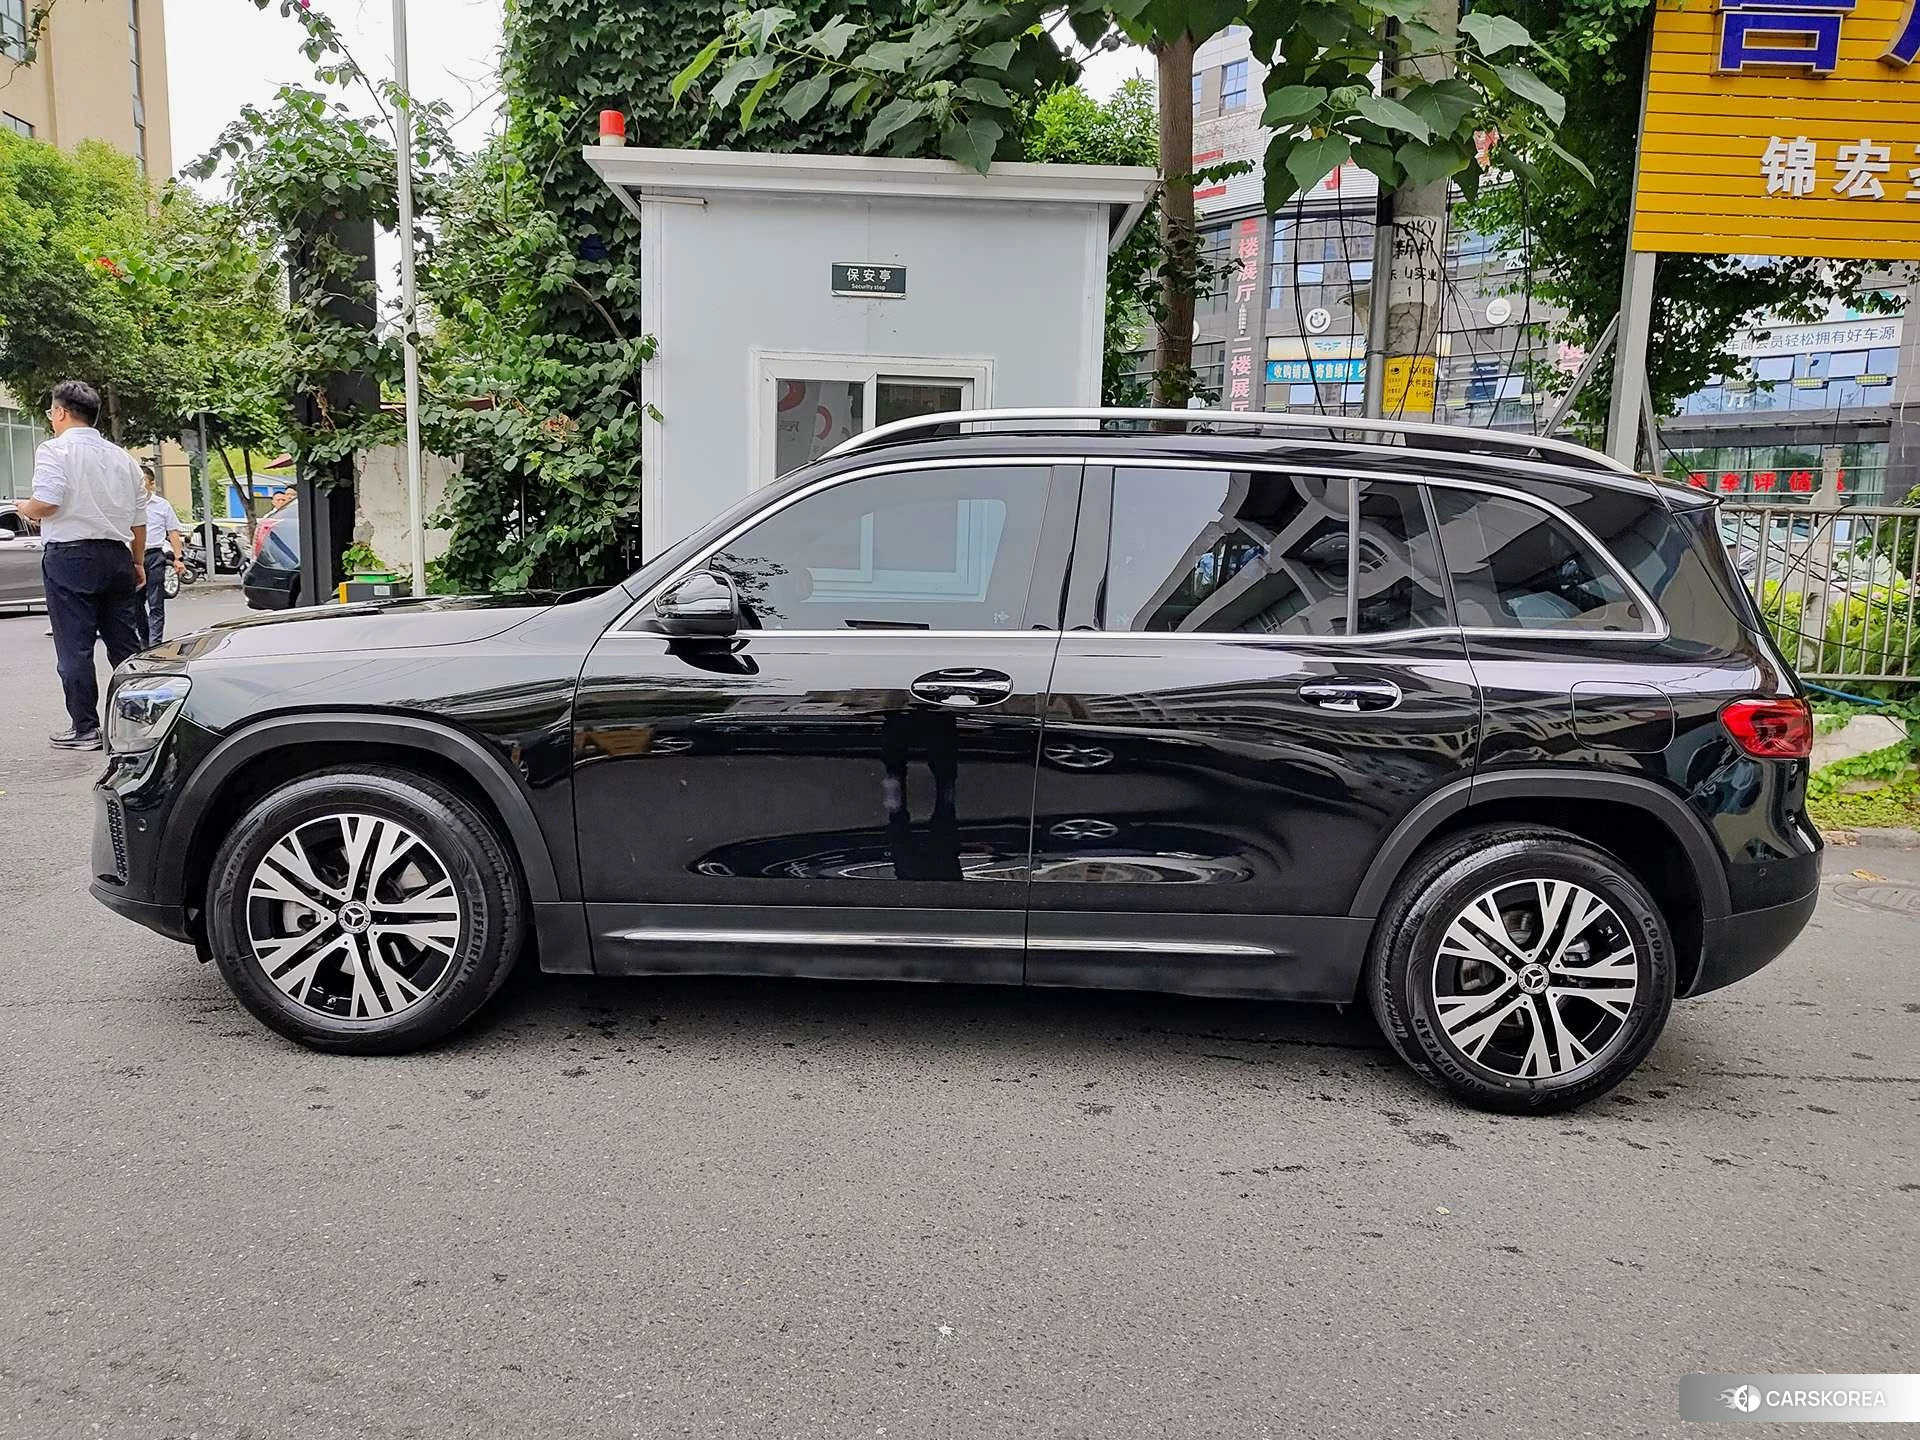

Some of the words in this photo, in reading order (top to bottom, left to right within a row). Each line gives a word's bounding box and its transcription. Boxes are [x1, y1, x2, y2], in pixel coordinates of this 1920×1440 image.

[1760, 136, 1920, 200] 锦宏
[846, 267, 892, 283] 保安亭
